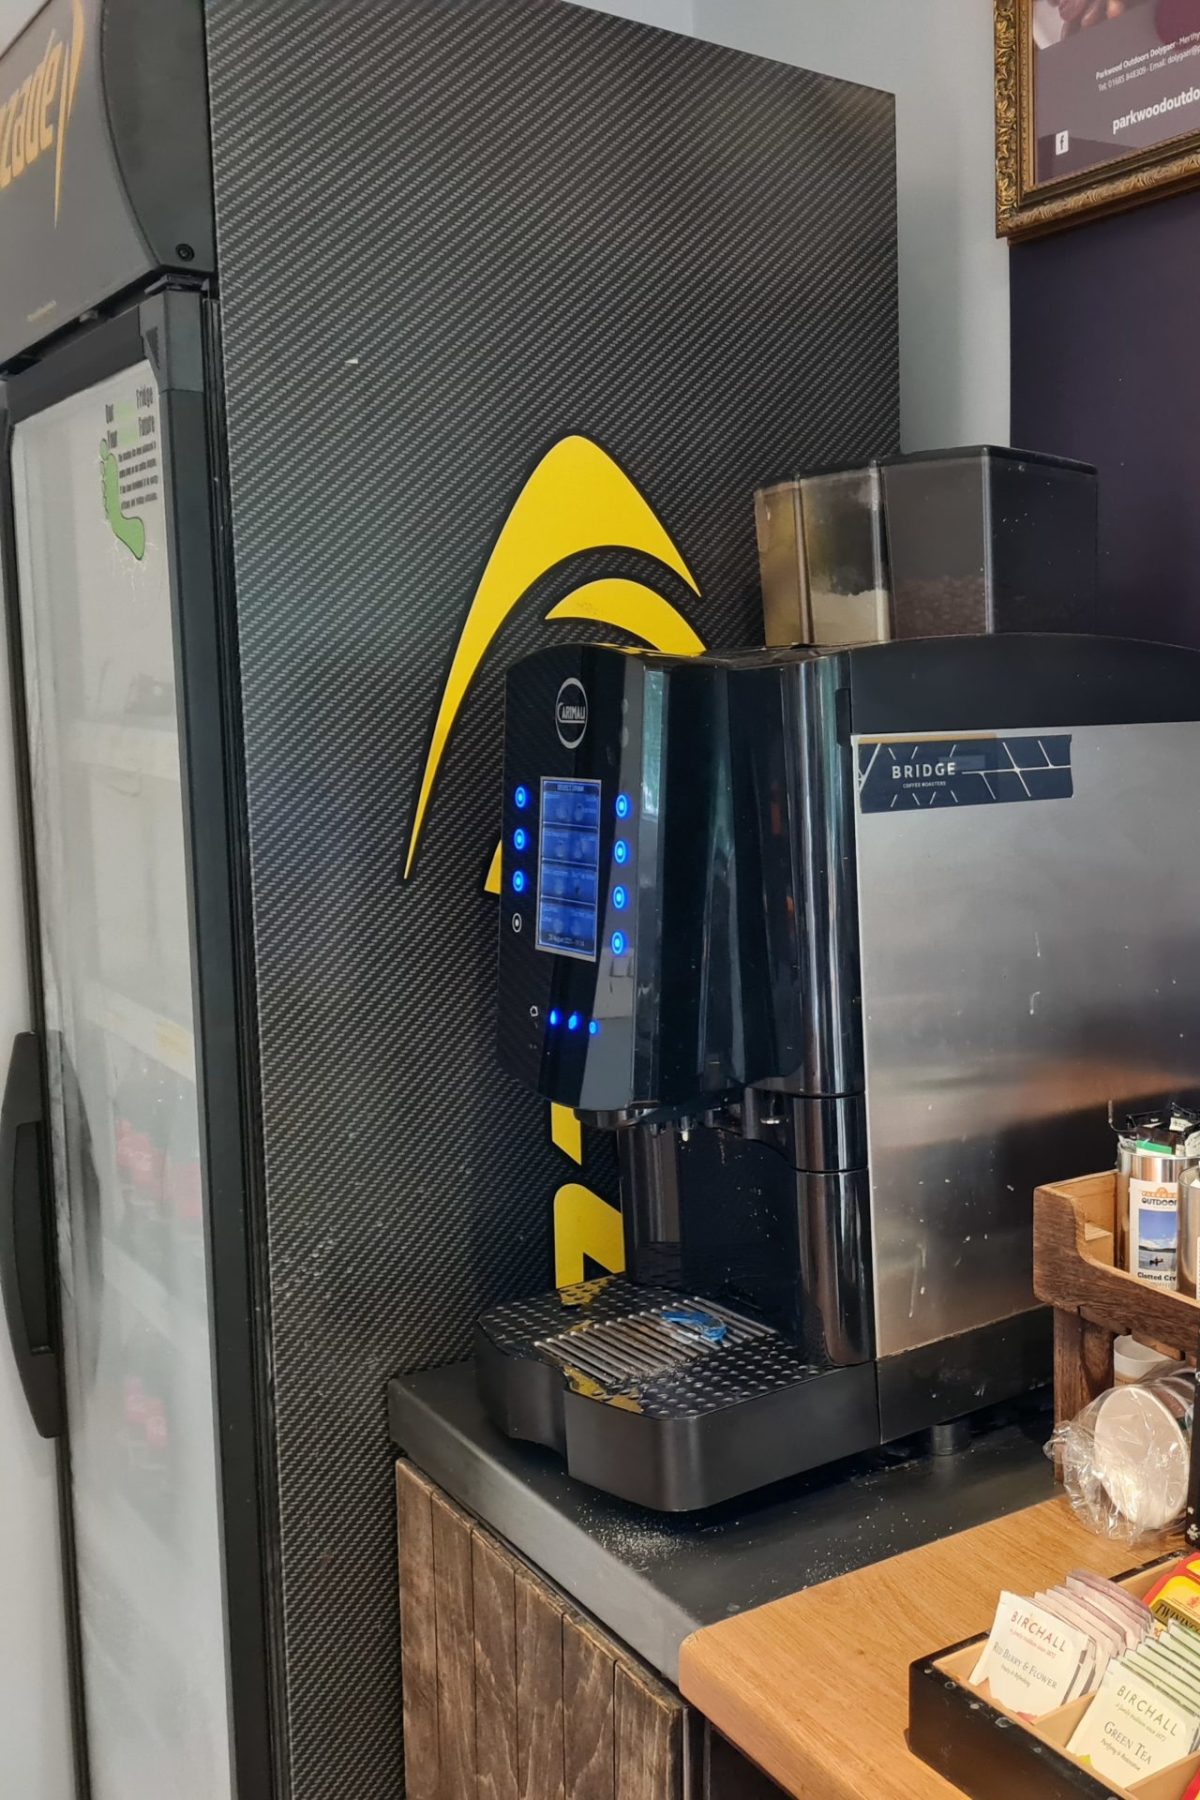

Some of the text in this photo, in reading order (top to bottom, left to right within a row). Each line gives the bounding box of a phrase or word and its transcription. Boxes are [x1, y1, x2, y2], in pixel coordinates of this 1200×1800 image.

[1095, 64, 1122, 80] Parkwood
[1122, 53, 1149, 69] Outdoors
[1150, 41, 1176, 58] Dolygaer
[892, 762, 956, 779] BRIDGE
[1137, 1271, 1162, 1281] Clotted
[1010, 1610, 1066, 1653] BIRCHALL
[1029, 1665, 1058, 1689] FLOWER
[1116, 1685, 1178, 1737] BIRCHALL
[1104, 1720, 1152, 1766] GREEN TEA
